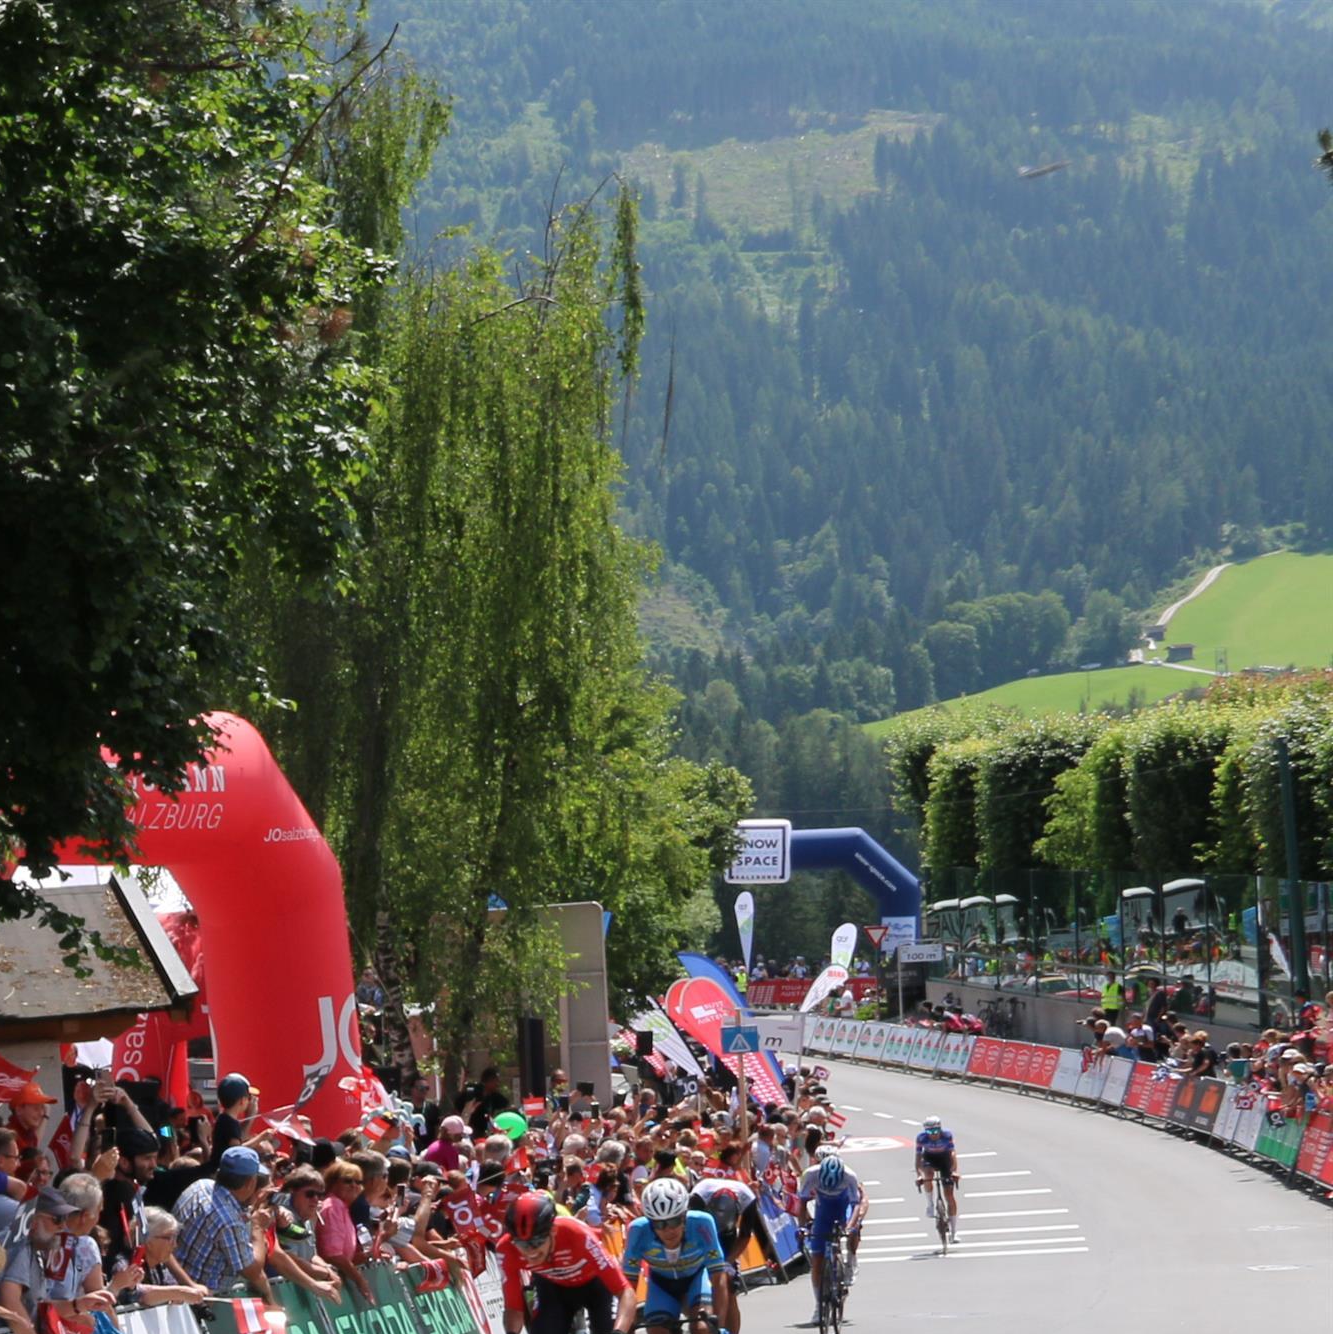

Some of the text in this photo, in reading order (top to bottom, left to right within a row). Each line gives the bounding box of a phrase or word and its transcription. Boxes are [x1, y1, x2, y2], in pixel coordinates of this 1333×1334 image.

[126, 803, 223, 830] ALZBURG
[736, 839, 778, 849] SNOW
[736, 856, 779, 867] SPACE
